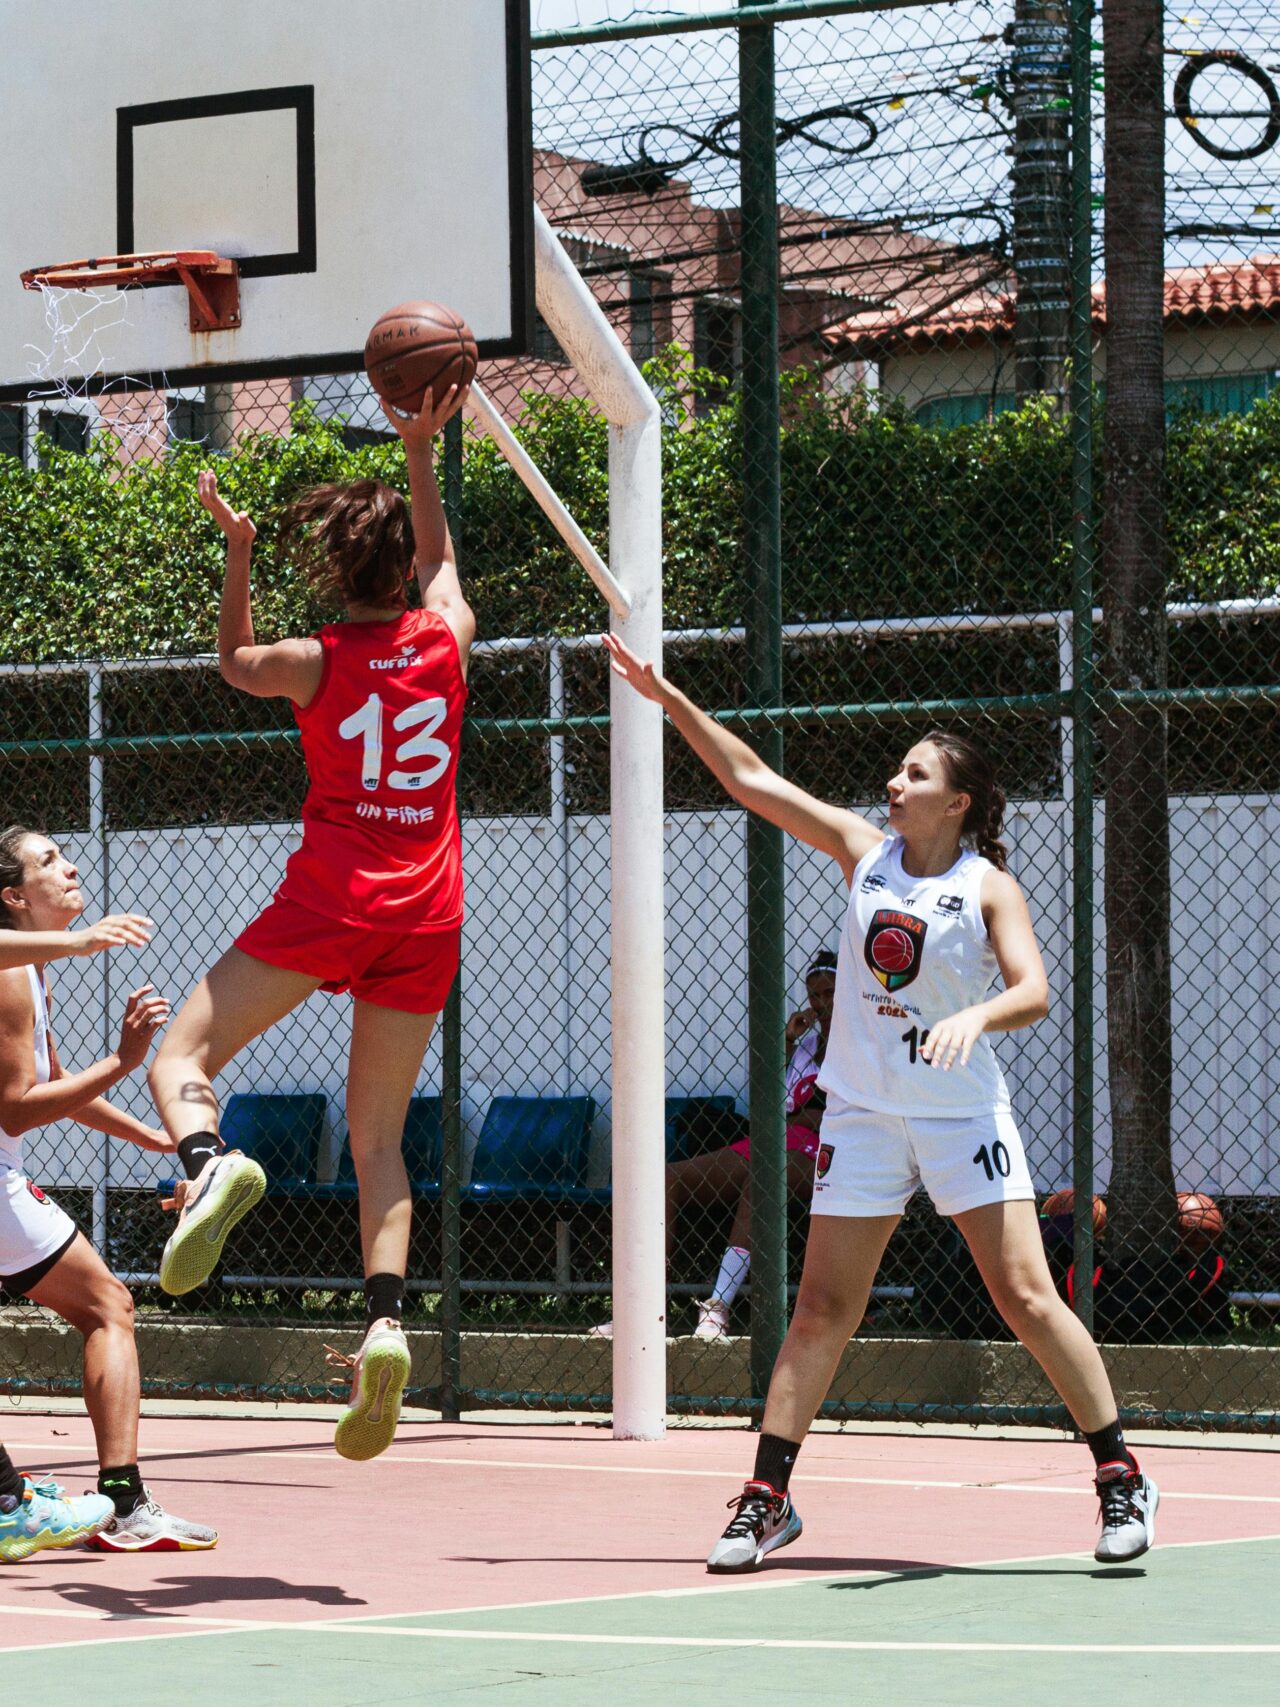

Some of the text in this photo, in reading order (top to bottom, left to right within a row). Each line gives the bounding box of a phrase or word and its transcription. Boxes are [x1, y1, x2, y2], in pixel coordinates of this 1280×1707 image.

[369, 657, 409, 670] CUFA
[338, 692, 452, 791] 13
[356, 802, 382, 820] ON
[972, 1139, 1011, 1182] 10
